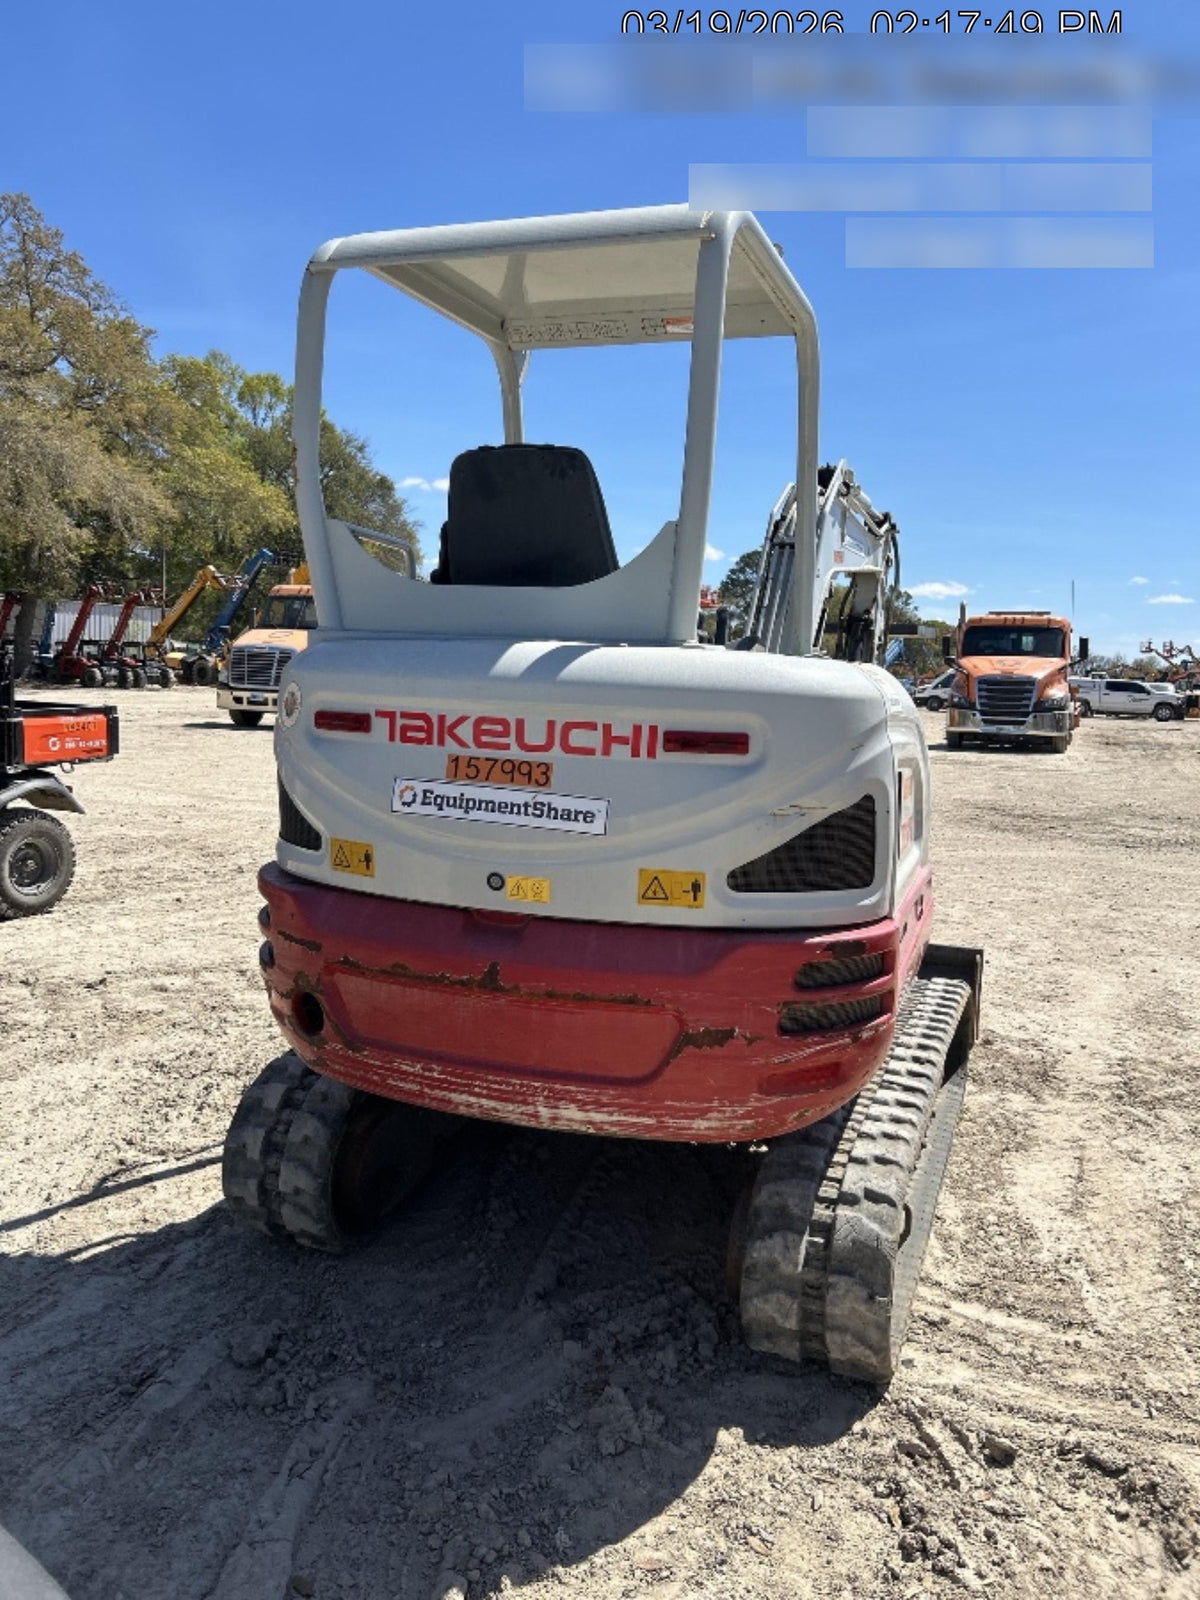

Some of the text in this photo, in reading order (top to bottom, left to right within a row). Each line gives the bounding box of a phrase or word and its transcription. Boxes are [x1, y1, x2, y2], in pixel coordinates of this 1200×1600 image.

[375, 710, 659, 759] TAKEUCHI
[449, 755, 552, 787] 157993
[420, 788, 597, 824] EquipmentShare
